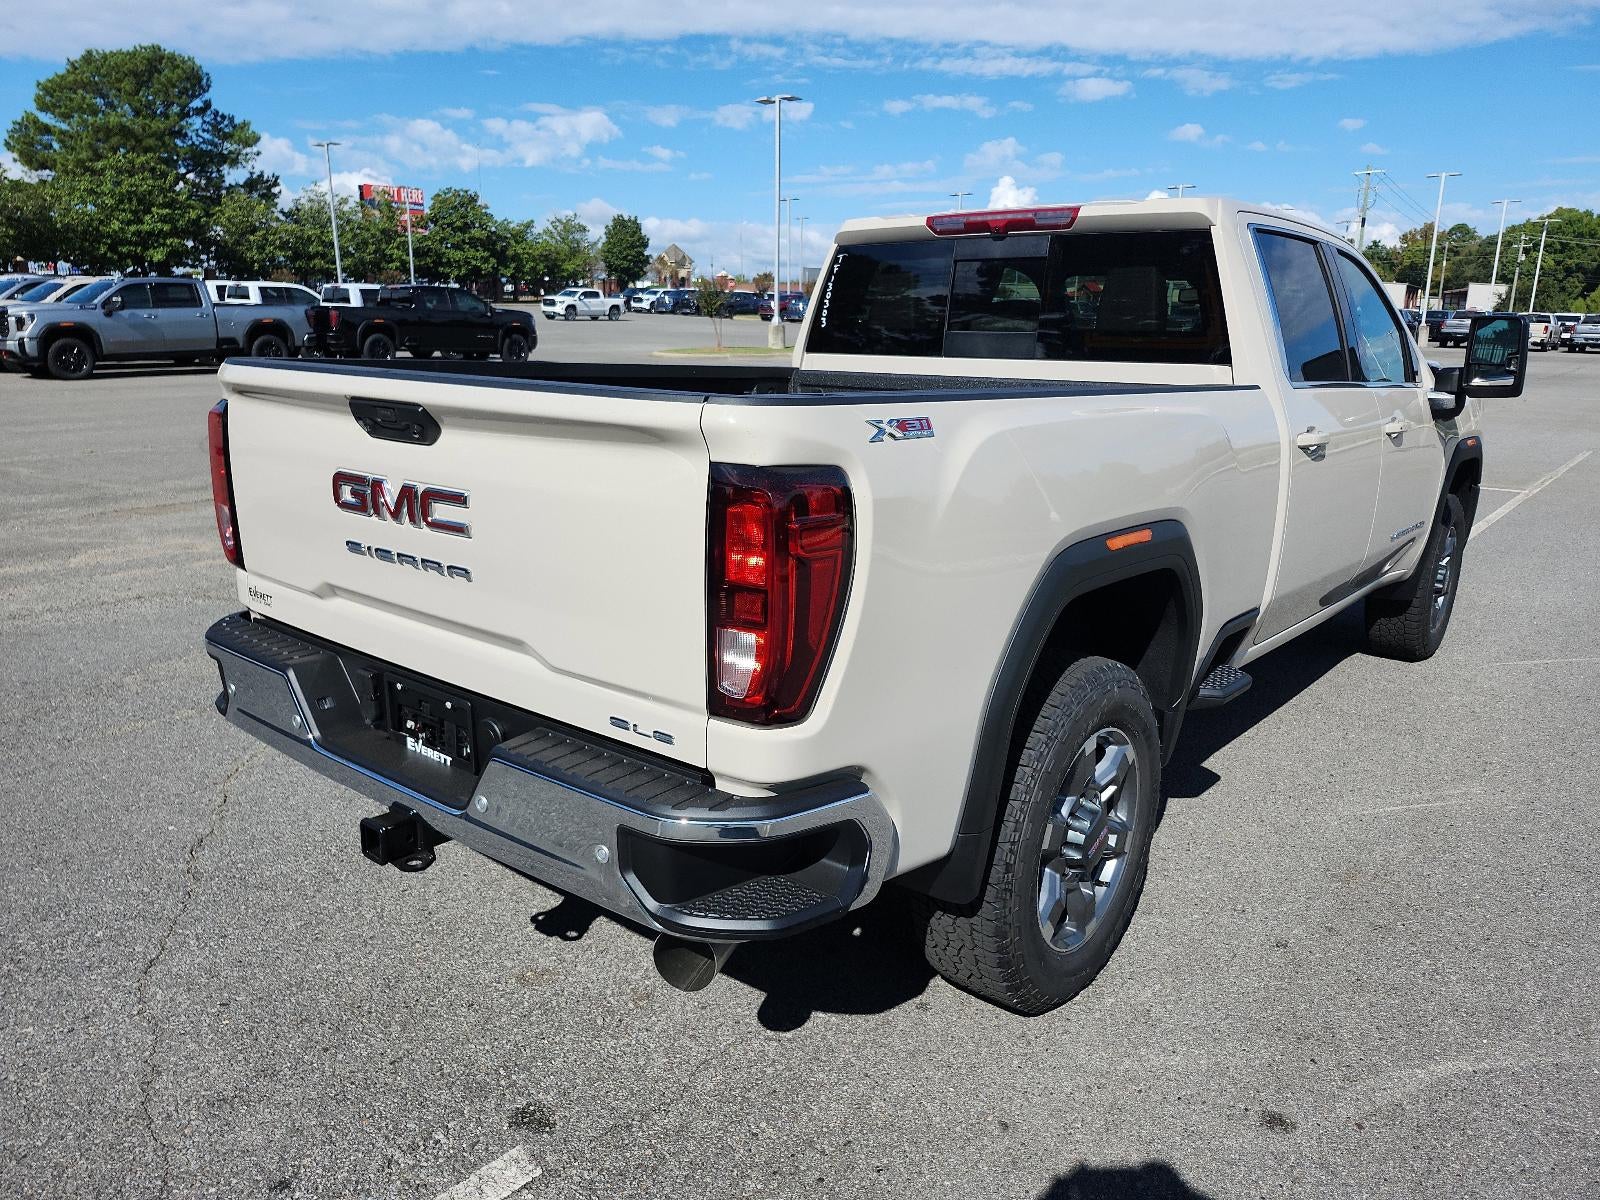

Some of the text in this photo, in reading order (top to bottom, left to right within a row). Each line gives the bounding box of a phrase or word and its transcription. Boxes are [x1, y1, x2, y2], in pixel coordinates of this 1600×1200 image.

[332, 468, 472, 539] GMC
[345, 540, 473, 582] SIERRA
[406, 737, 453, 767] EVERETT
